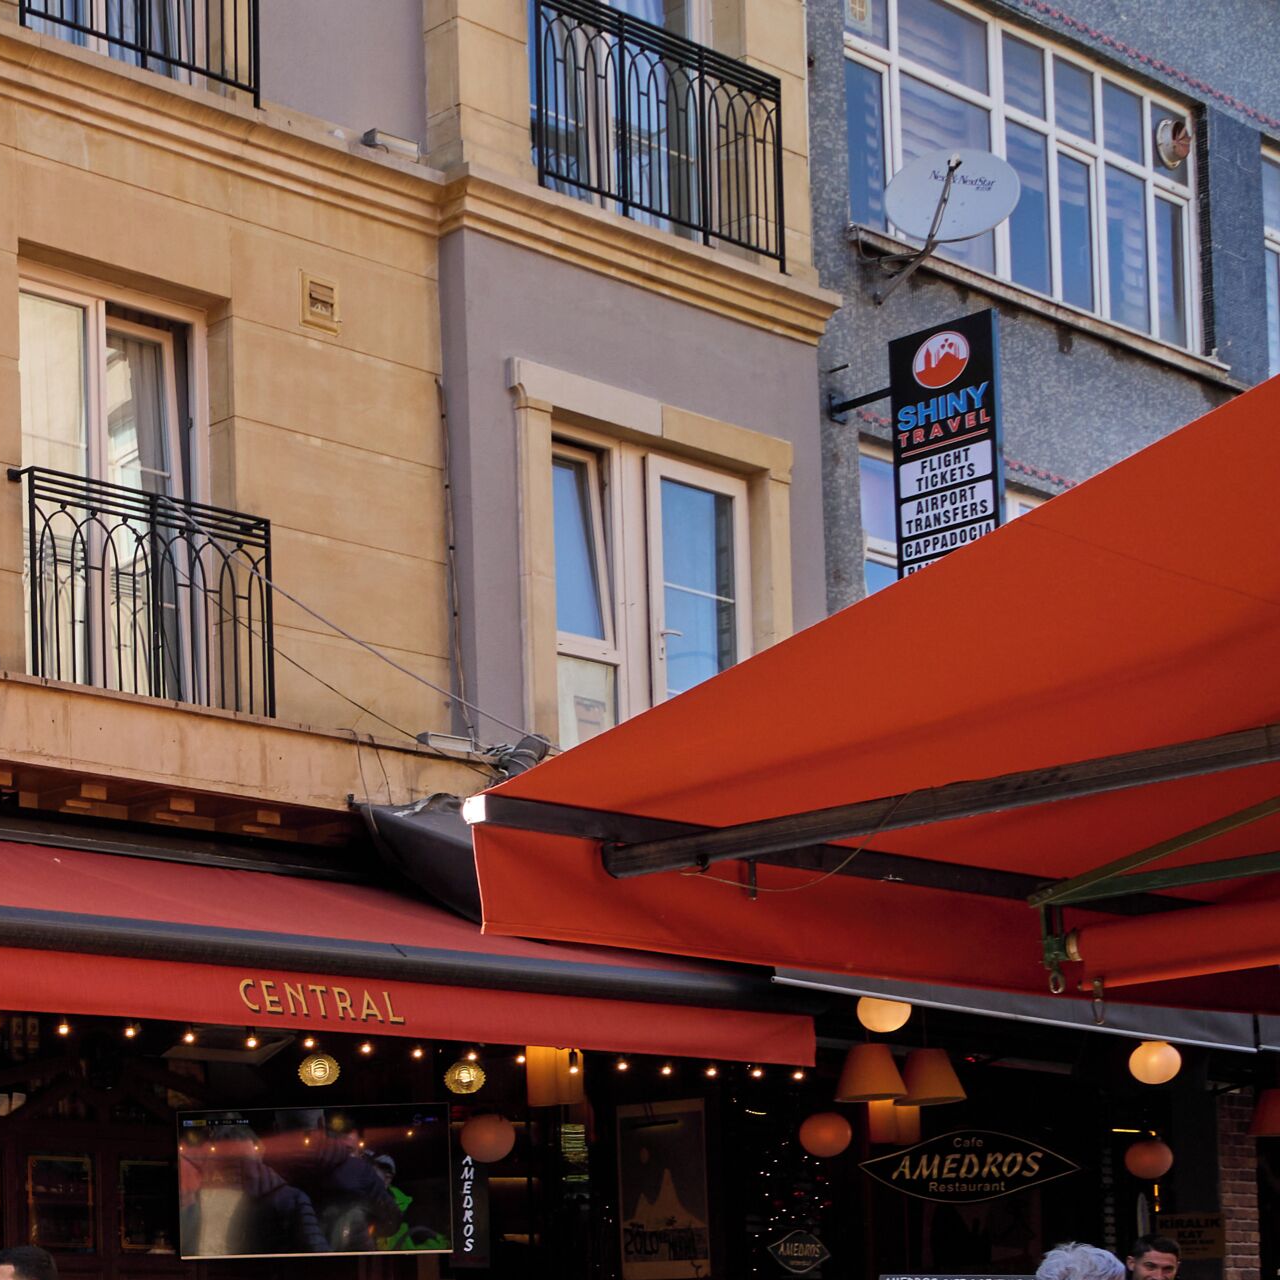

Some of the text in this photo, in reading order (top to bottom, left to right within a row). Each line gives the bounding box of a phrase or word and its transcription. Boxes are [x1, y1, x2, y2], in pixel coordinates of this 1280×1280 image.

[897, 381, 989, 432] SHINY
[898, 408, 991, 448] TRAVEL
[920, 447, 971, 475] FLIGHT
[915, 462, 975, 492] TICKETS
[915, 485, 977, 516] AIRPORT
[905, 499, 988, 535] TRANSFERS
[239, 978, 406, 1025] CENTRAL
[952, 1137, 984, 1148] Cafe
[891, 1151, 1044, 1180] AMEDROS
[928, 1181, 1006, 1193] Restaurant
[460, 1155, 475, 1252] AMEDROS
